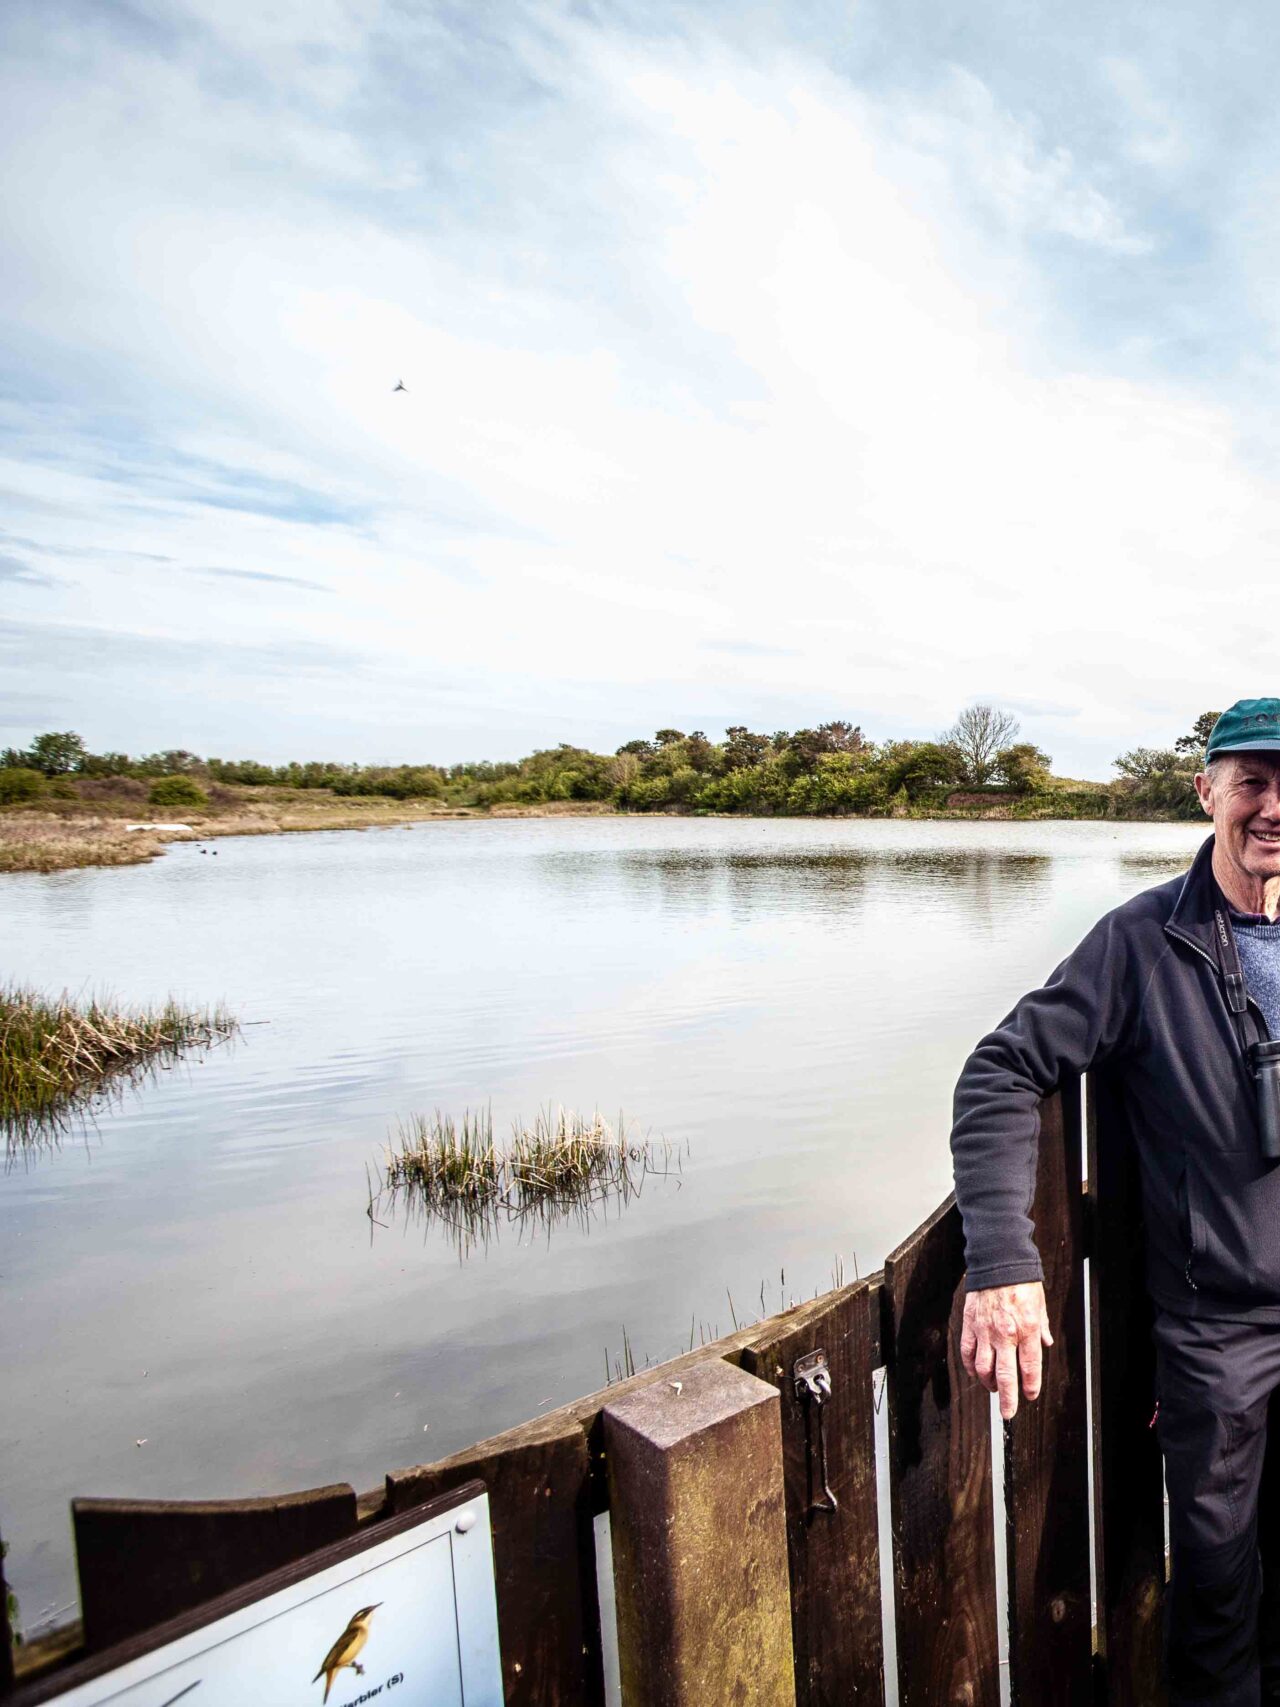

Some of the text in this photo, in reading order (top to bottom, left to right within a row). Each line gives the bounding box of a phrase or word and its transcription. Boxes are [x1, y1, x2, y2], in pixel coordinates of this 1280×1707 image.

[1215, 910, 1229, 947] opticron
[341, 1672, 404, 1707] arbler (S)
